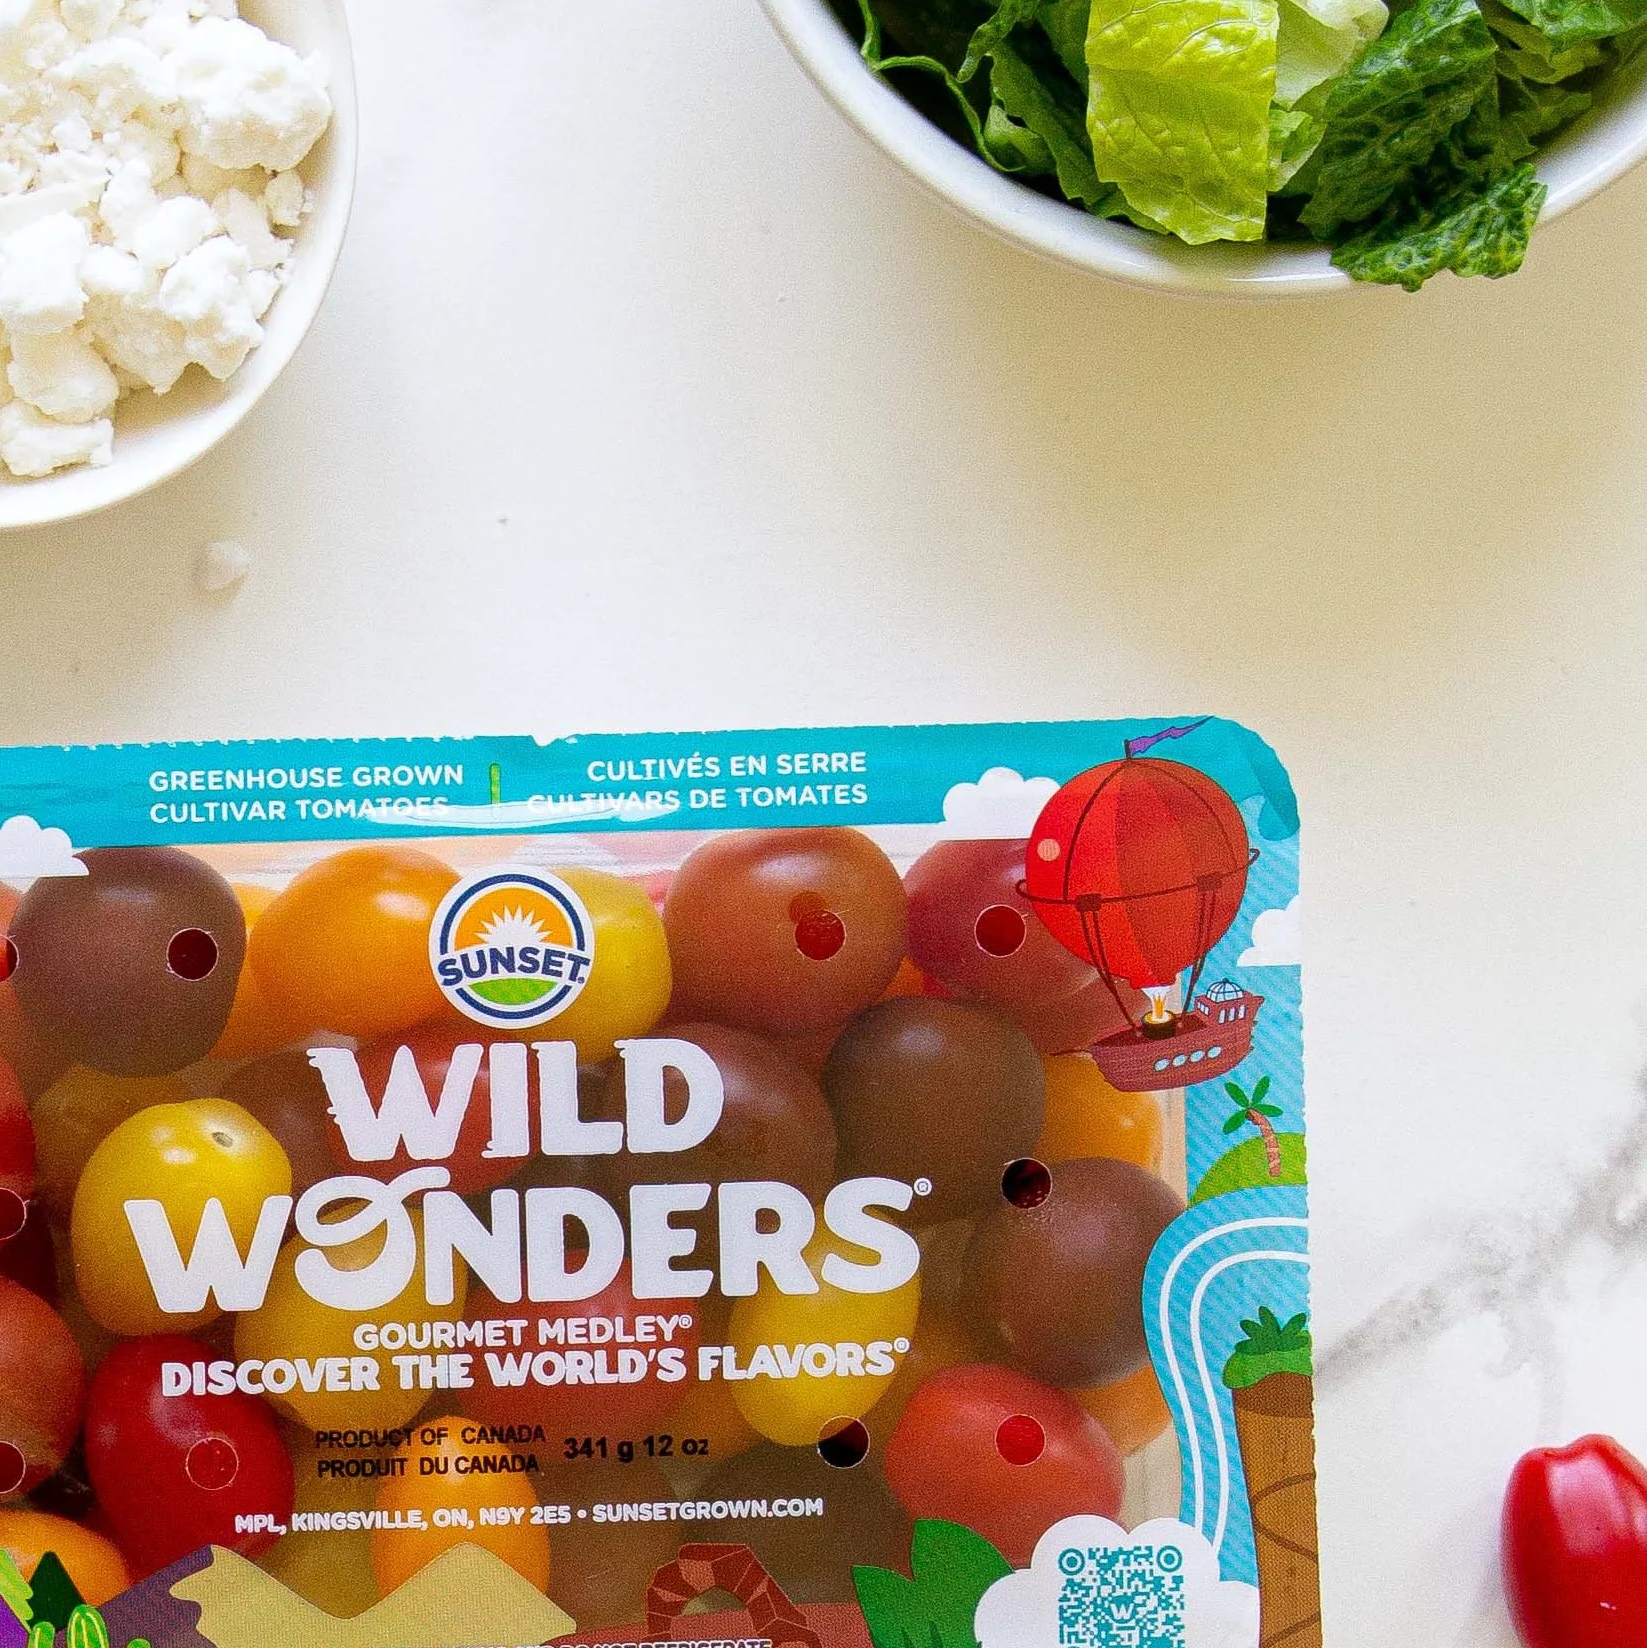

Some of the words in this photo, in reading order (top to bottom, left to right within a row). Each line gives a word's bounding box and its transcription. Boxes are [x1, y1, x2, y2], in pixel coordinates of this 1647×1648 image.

[150, 767, 343, 792] GREENHOUSE
[353, 764, 464, 788] GROWN
[587, 752, 720, 782] CULTIVÉS
[730, 755, 767, 777] EN
[777, 751, 867, 775] SERRE
[150, 800, 284, 825] CULTIVAR
[295, 796, 448, 820] TOMATOES
[527, 788, 680, 815] CULTIVARS
[690, 788, 726, 810] DE
[735, 784, 868, 808] TOMATES
[306, 1038, 725, 1161] WILD
[353, 1319, 529, 1350] GOURMET
[162, 1357, 380, 1397] DISCOVER
[389, 1353, 473, 1390] THE
[486, 1347, 687, 1386] WORLD'S
[316, 1429, 412, 1449] PRODUCT
[421, 1427, 448, 1446] OF
[461, 1425, 545, 1445] CANADA
[564, 1437, 608, 1459] 341
[617, 1439, 634, 1463] g
[641, 1435, 673, 1457] 12
[682, 1437, 709, 1456] oz
[318, 1458, 406, 1478] PRODUIT
[420, 1457, 449, 1476] DU
[454, 1454, 539, 1475] CANADA
[234, 1515, 285, 1536] MPL,
[292, 1510, 428, 1533] KINGSVILLE,
[529, 1506, 571, 1525] 2E5
[592, 1497, 824, 1524] SUNSETGROWN.COM
